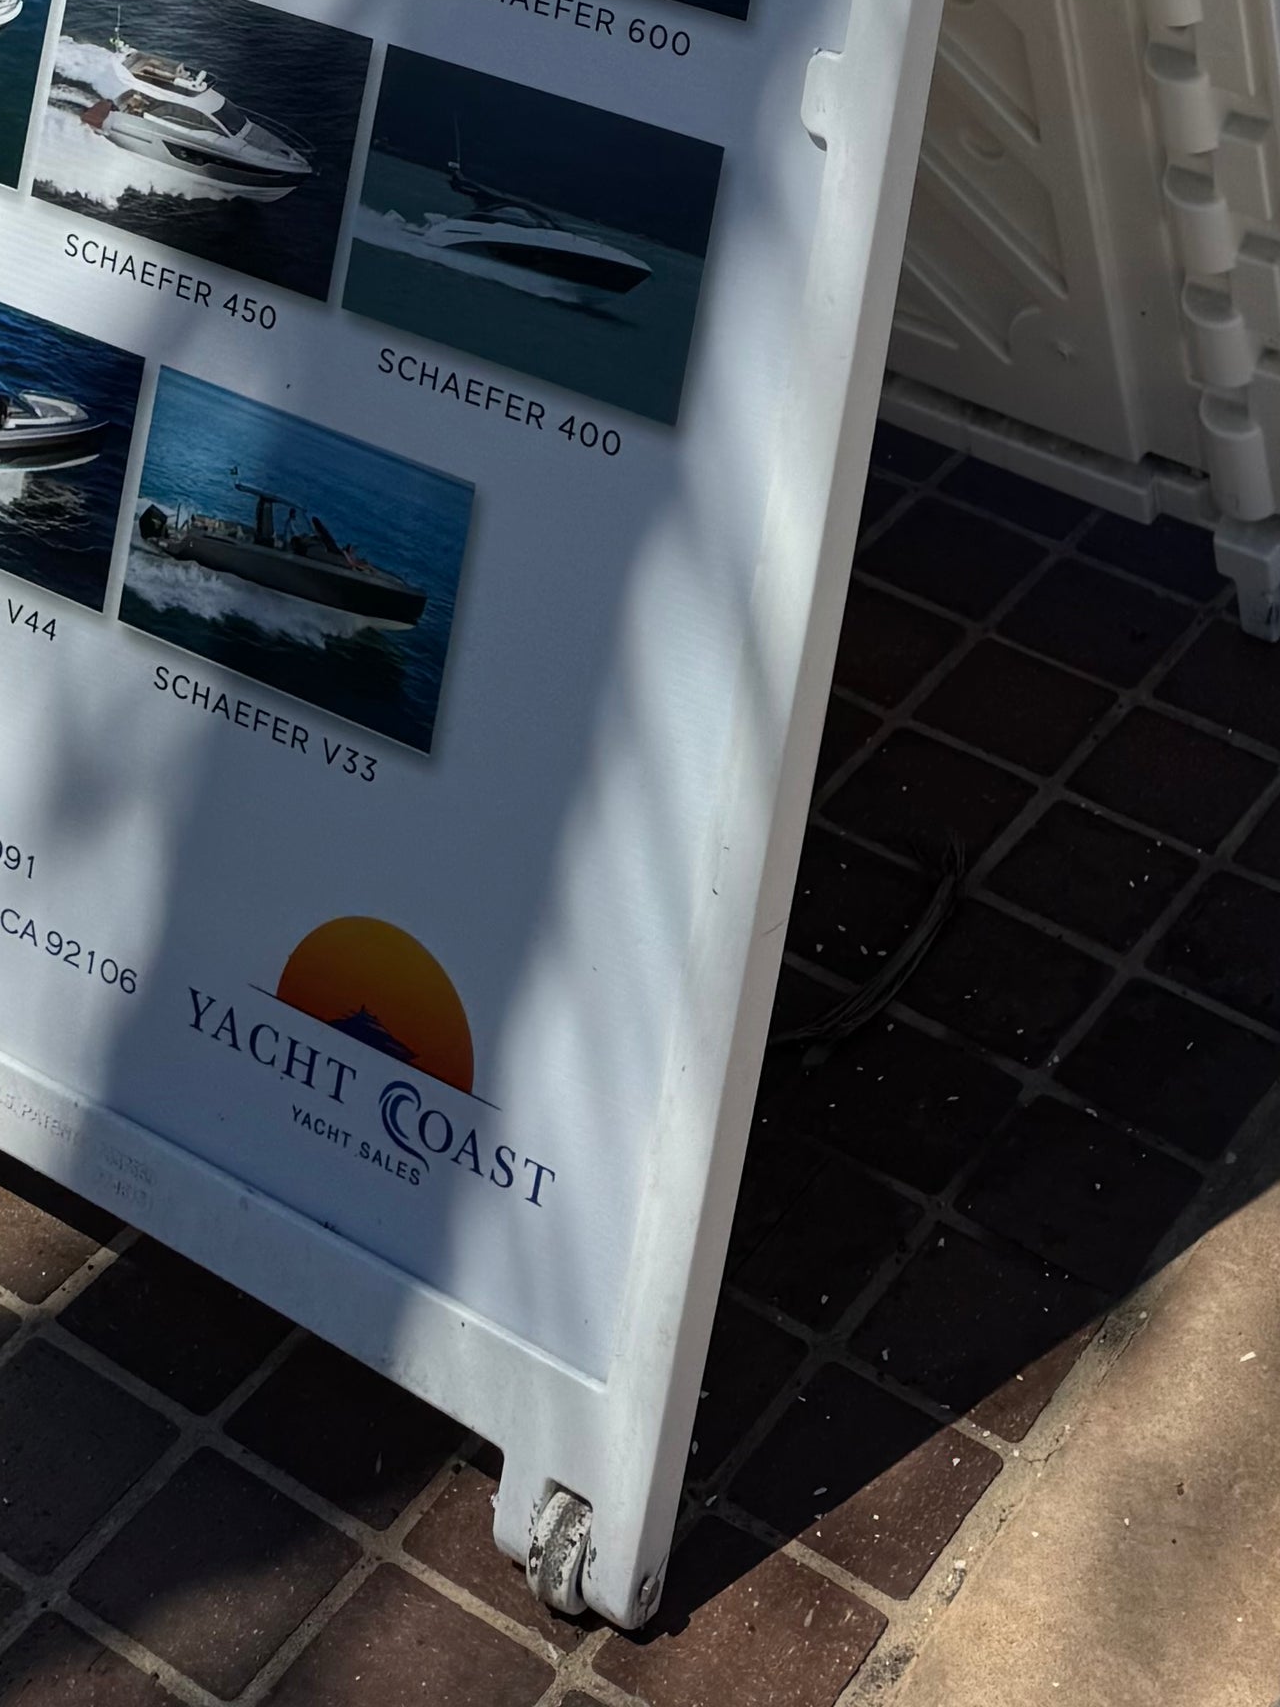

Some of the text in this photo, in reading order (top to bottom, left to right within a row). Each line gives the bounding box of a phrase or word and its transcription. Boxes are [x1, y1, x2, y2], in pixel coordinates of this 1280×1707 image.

[627, 17, 691, 57] 600
[63, 232, 277, 331] SCHAEFER 450
[376, 347, 622, 457] SCHAEFER 400
[6, 597, 57, 642] V44
[152, 665, 379, 783] SCHAEFER V33
[0, 907, 39, 949] CA
[45, 930, 139, 995] 92106
[186, 986, 556, 1208] YACHT COAST
[291, 1103, 421, 1187] YACHT SALES
